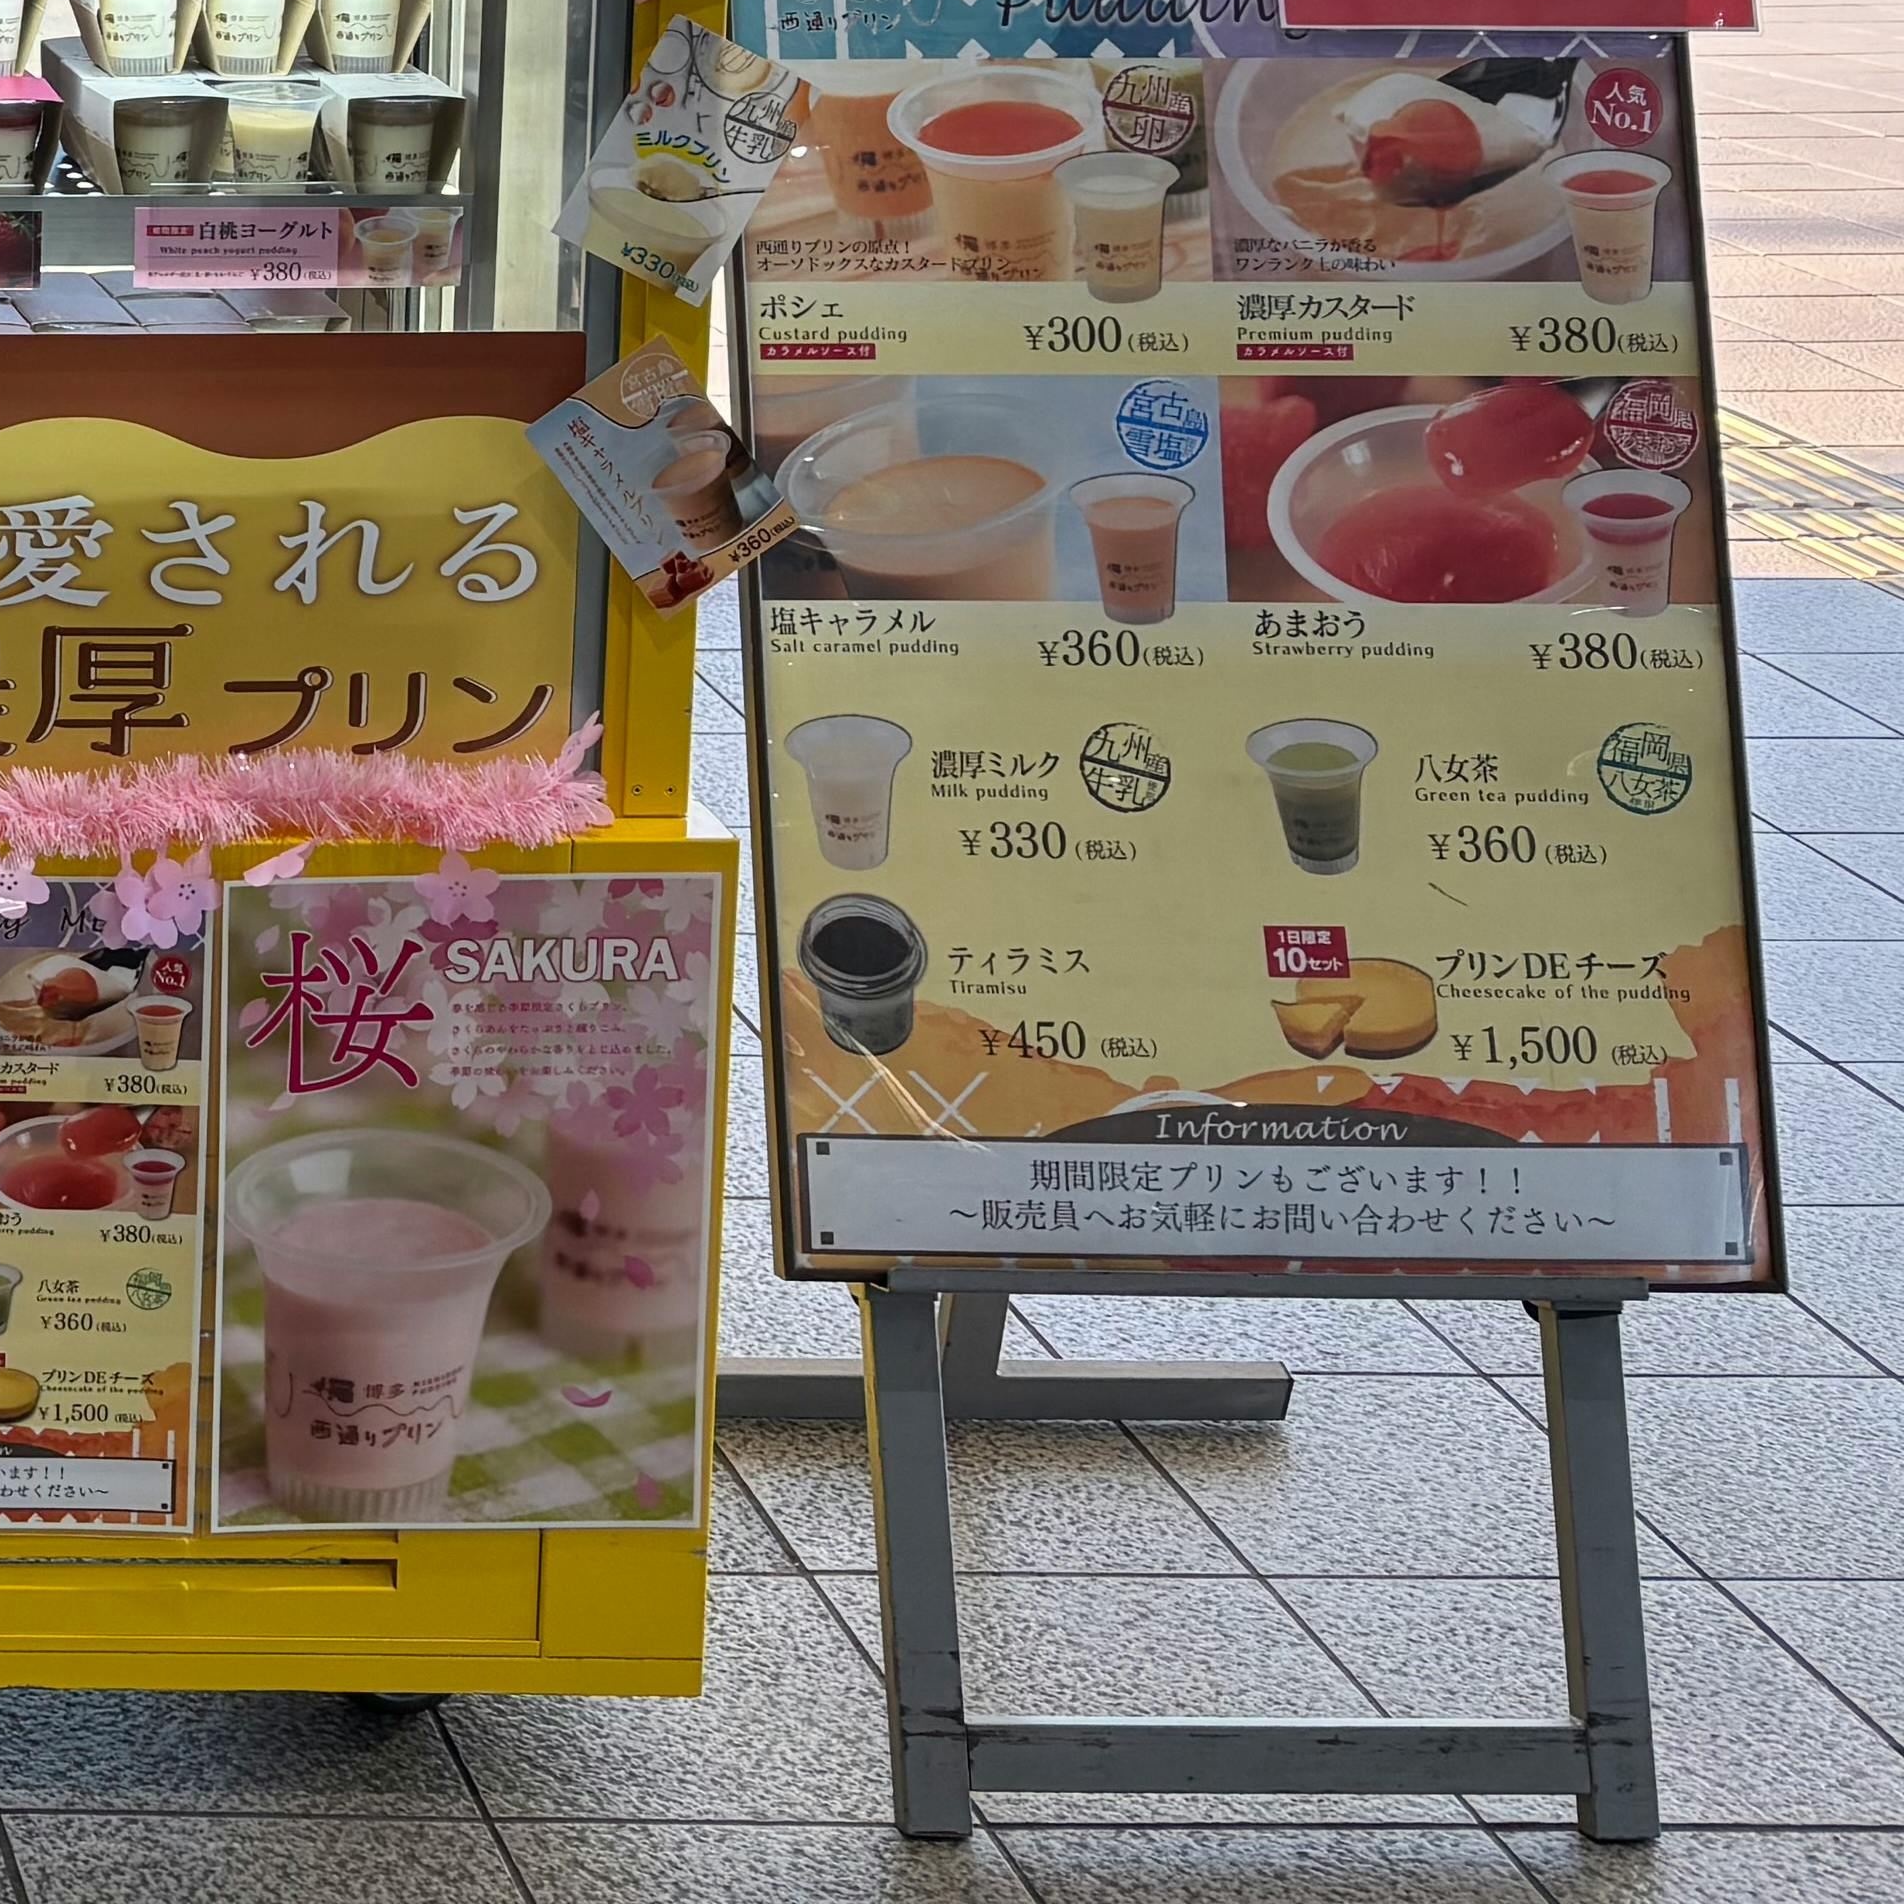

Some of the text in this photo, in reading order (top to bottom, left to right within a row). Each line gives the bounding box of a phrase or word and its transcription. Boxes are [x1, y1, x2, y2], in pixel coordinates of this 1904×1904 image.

[1604, 82, 1648, 105] 人気
[1589, 99, 1656, 137] No.1
[198, 218, 335, 244] 白桃ヨーグルト
[759, 293, 845, 322] ポシェ
[1237, 293, 1416, 324] 濃厚カスタード
[758, 324, 909, 346] Custard pudding
[1236, 324, 1393, 346] Premium pudding
[769, 607, 937, 638] 塩キャラメル
[1252, 607, 1368, 639] あまおう
[769, 637, 961, 660] Salt caramel pudding
[1251, 641, 1435, 663] Strawberry pudding
[929, 750, 1062, 780] 濃厚ミルク
[1414, 752, 1500, 784] 八女茶
[929, 782, 1050, 804] Milk pudding
[1413, 785, 1590, 808] Green tea pudding
[442, 935, 680, 984] SAKURA
[948, 946, 1093, 975] ティラミス
[1433, 950, 1669, 983] プリンDEチーズ
[948, 979, 1028, 998] Tiramisu
[1436, 983, 1692, 1004] Cheesecake of the pudding
[244, 929, 436, 1096] 桜
[978, 1020, 1087, 1064] ¥450
[1452, 1023, 1598, 1070] ¥1,500
[1155, 1108, 1409, 1144] Information
[1029, 1157, 1525, 1199] 期間限定プリンもございます!!
